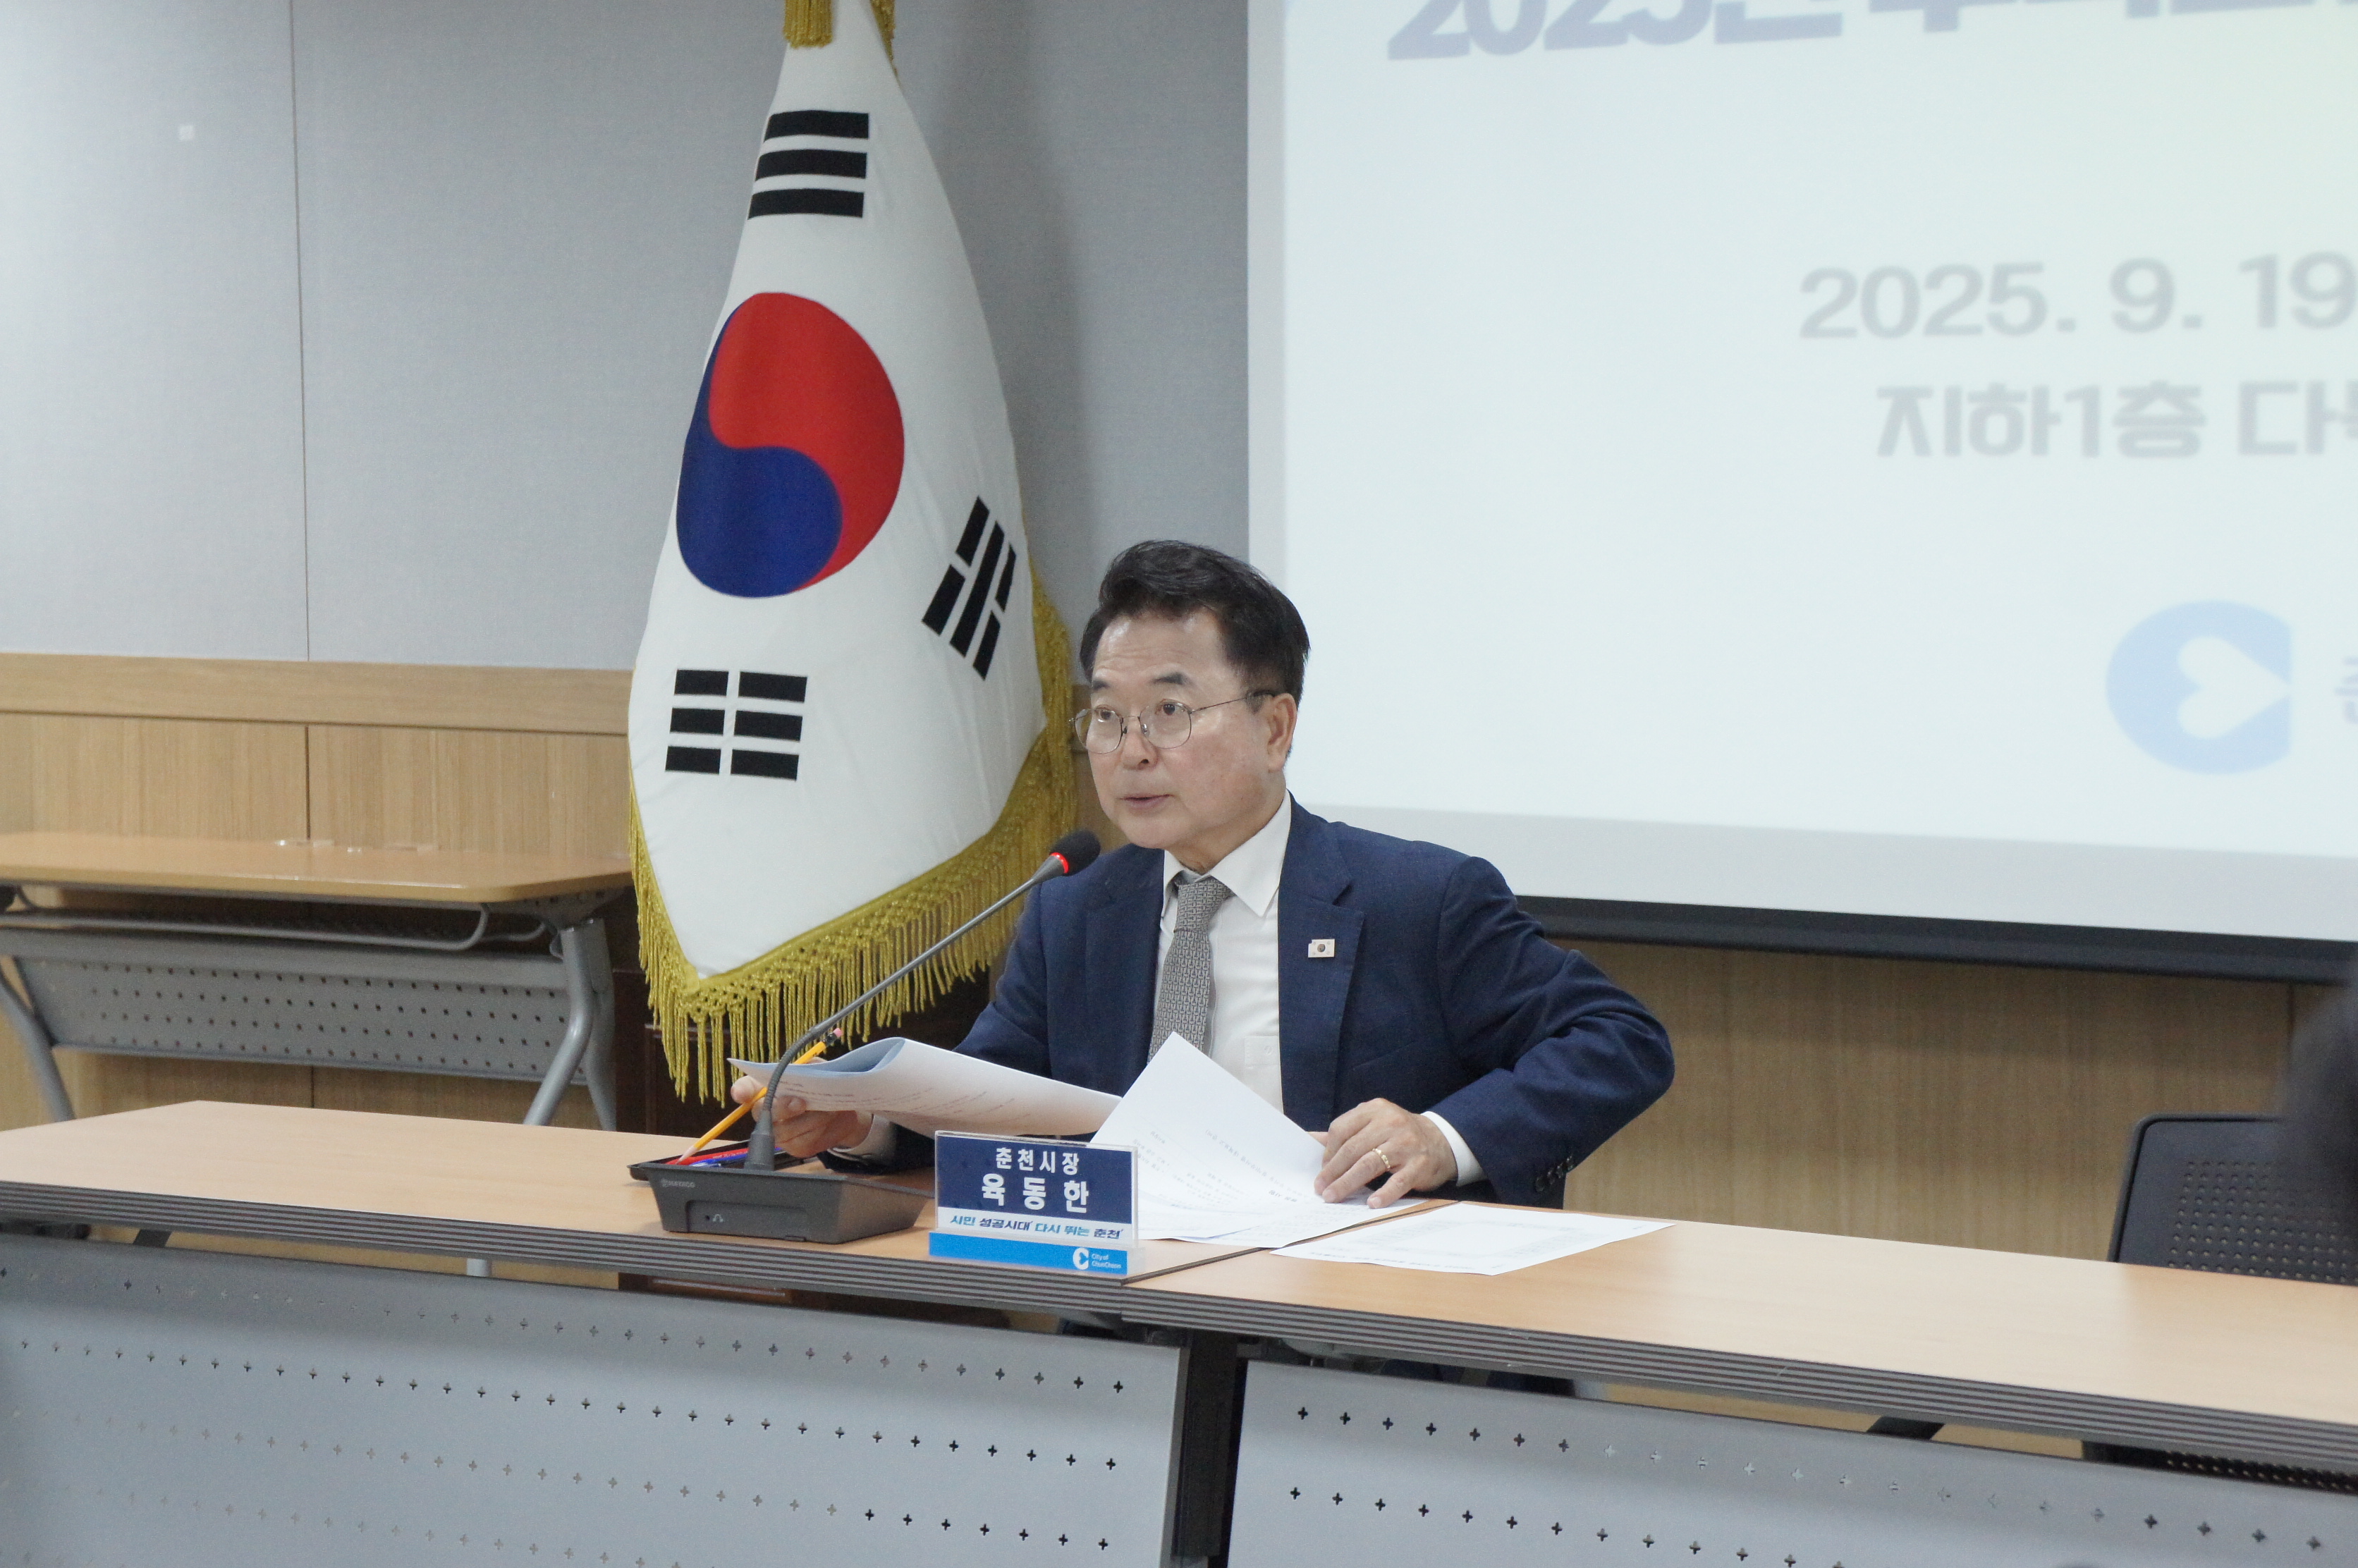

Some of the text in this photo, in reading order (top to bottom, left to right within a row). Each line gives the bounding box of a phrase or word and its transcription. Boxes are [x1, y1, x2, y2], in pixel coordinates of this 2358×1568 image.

[1800, 251, 2358, 338] 2025. 9. 19
[1876, 379, 2358, 458] 지하1층 다
[996, 1147, 1080, 1176] 춘천시장
[982, 1172, 1089, 1213] 육동한
[950, 1215, 976, 1227] 시민
[1034, 1223, 1061, 1235] 다시
[1065, 1225, 1090, 1237] 뛰는
